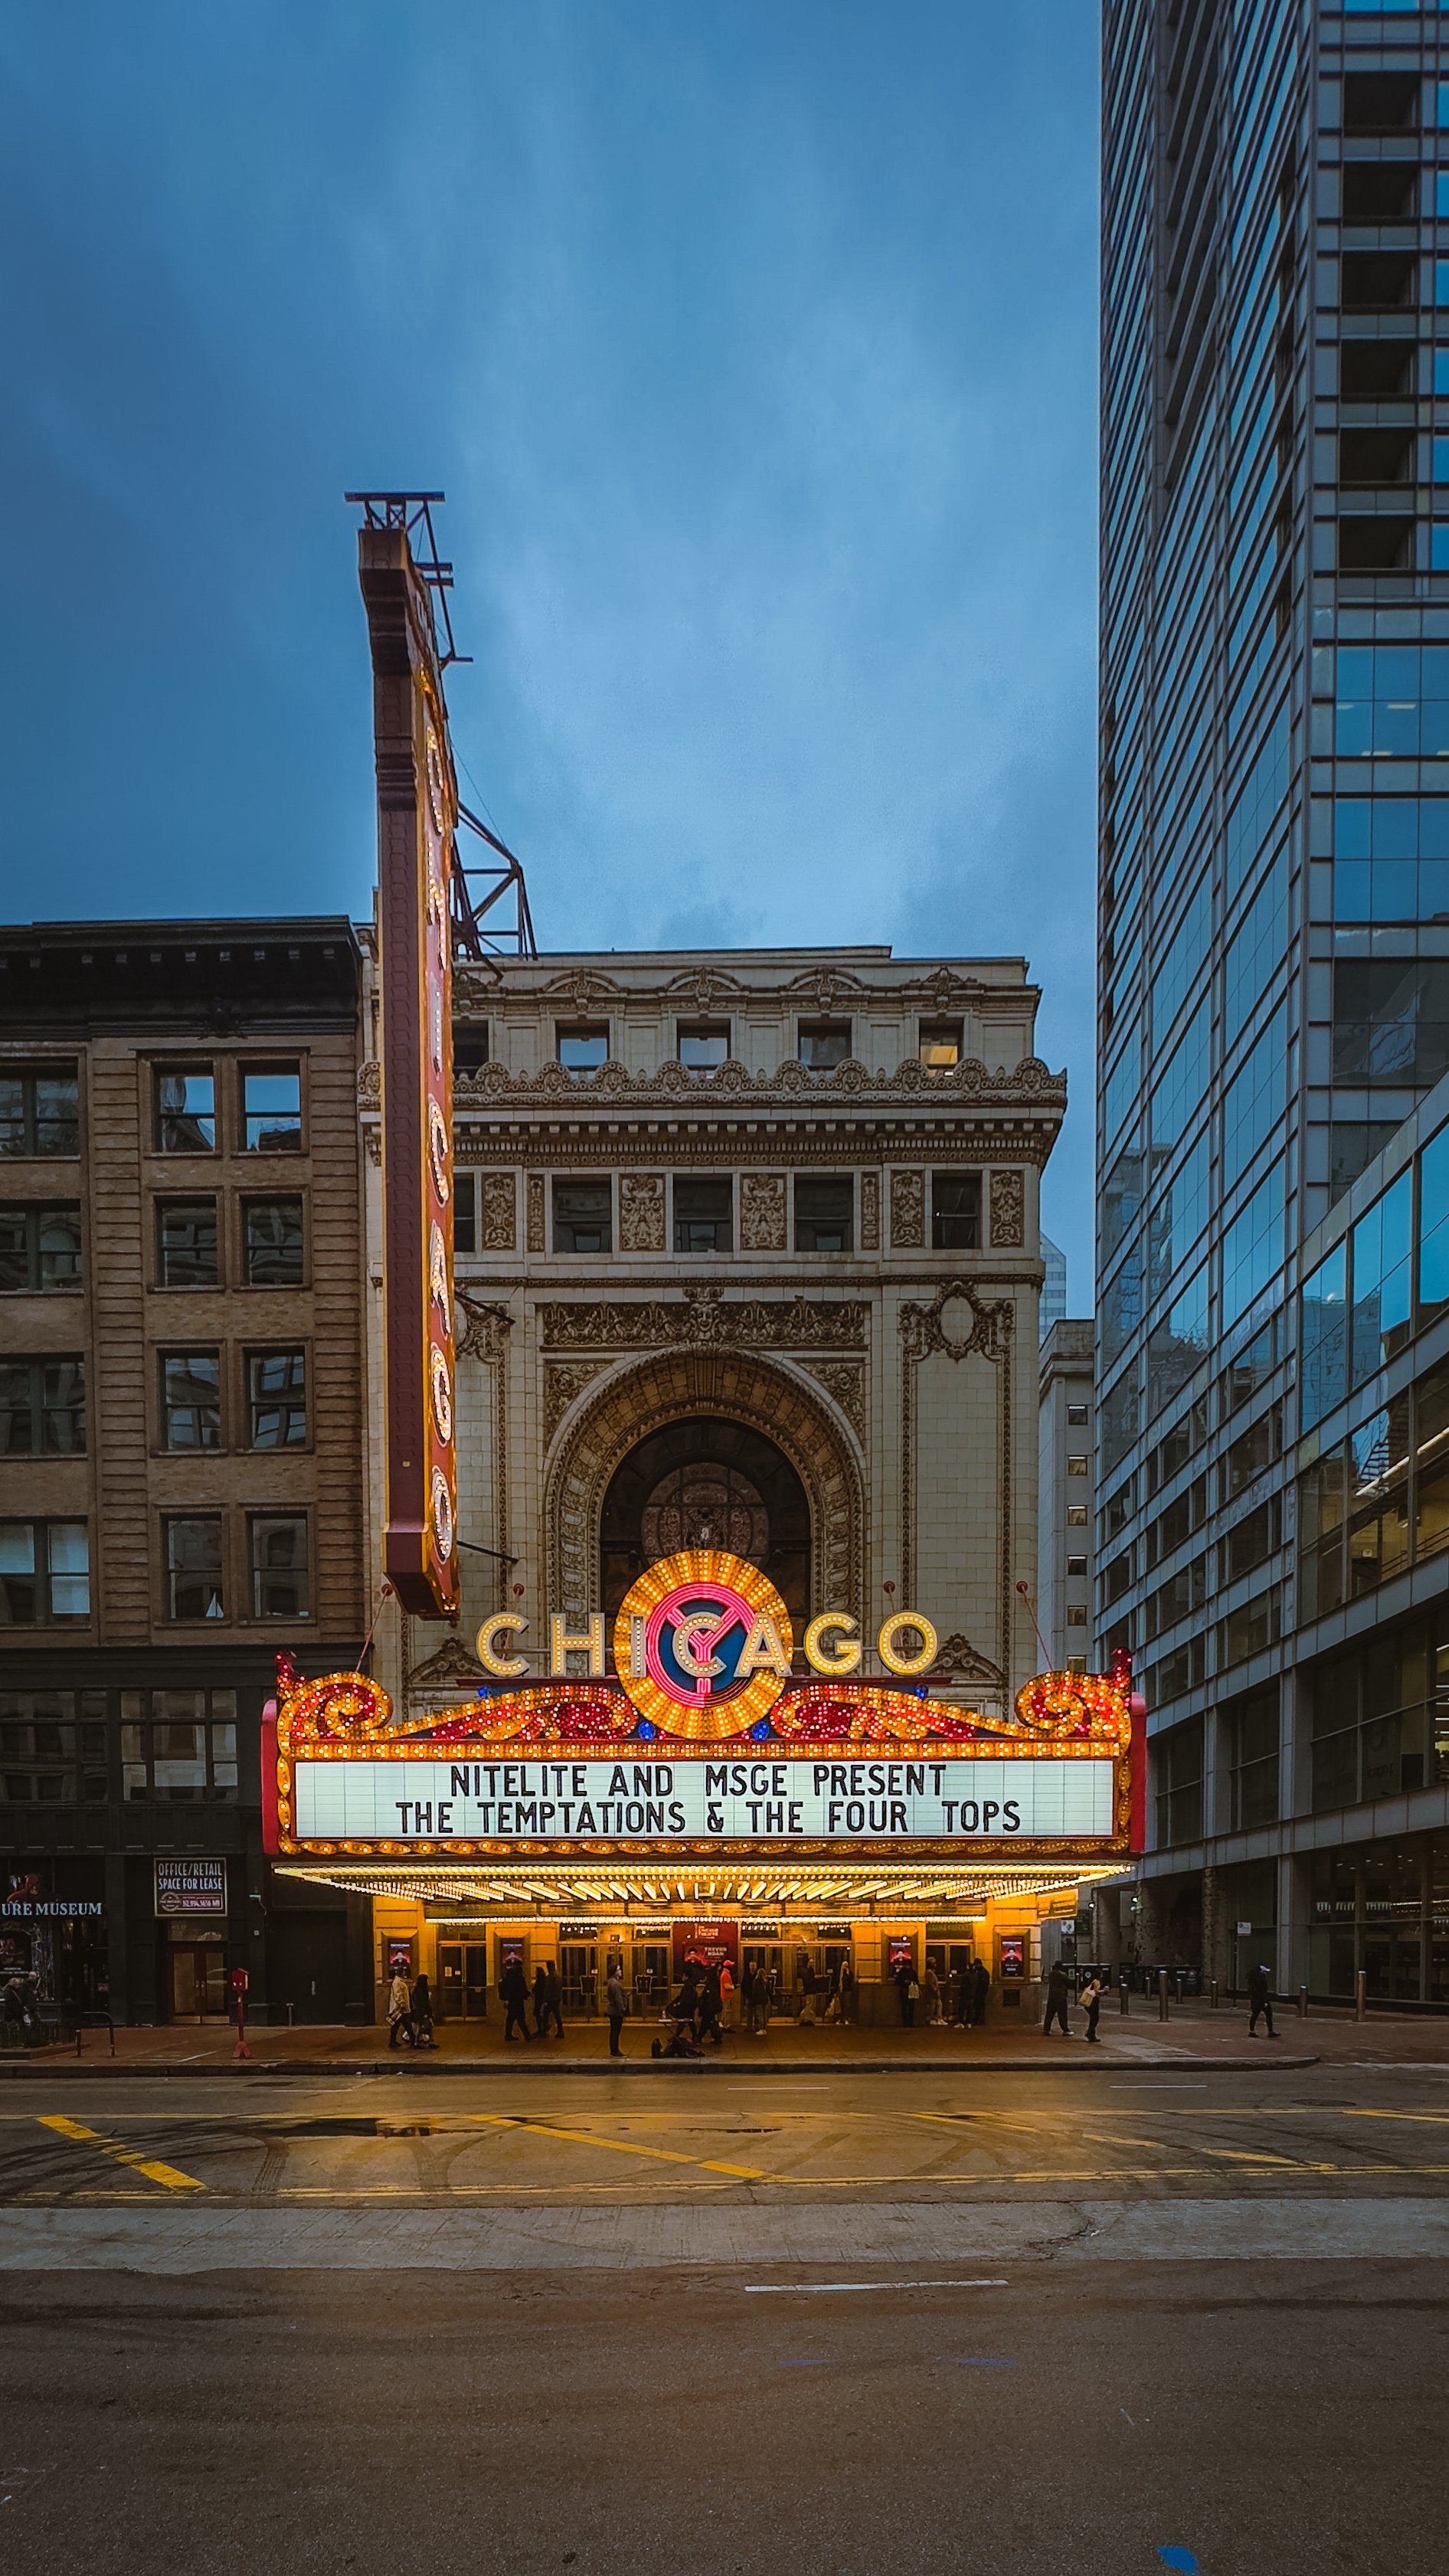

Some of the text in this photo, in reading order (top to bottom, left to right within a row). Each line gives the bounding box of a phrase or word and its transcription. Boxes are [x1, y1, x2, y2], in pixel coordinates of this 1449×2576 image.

[476, 1610, 939, 1678] CHICAGO
[450, 1764, 947, 1798] NITELITE AND MSGE PRESENT
[395, 1800, 1021, 1834] THE TEMPTATIONS & THE FOUR TOPS
[158, 1863, 222, 1876] OFFICE/RETAIL
[159, 1878, 222, 1890] SPACE FOR LEASE
[2, 1903, 102, 1915] URE MUSEUM
